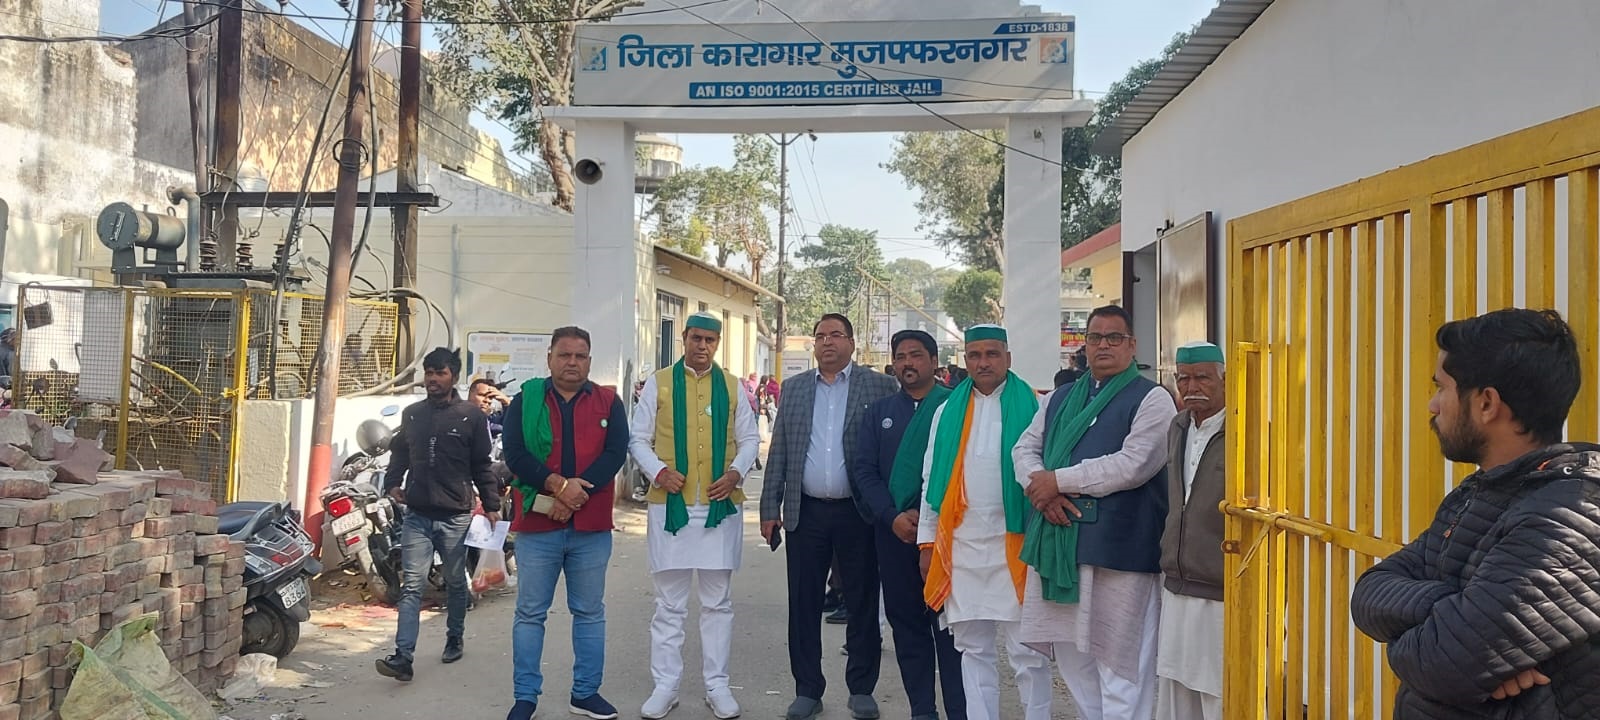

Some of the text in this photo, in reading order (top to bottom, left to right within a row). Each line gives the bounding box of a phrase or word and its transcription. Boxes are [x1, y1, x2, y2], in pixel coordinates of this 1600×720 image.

[1008, 22, 1069, 33] ESTD-1838
[617, 34, 1030, 79] जिला कारागार मुजफ्फरनगर
[696, 82, 937, 97] AN ISO 9001:2015 CERTIFIED JAIL
